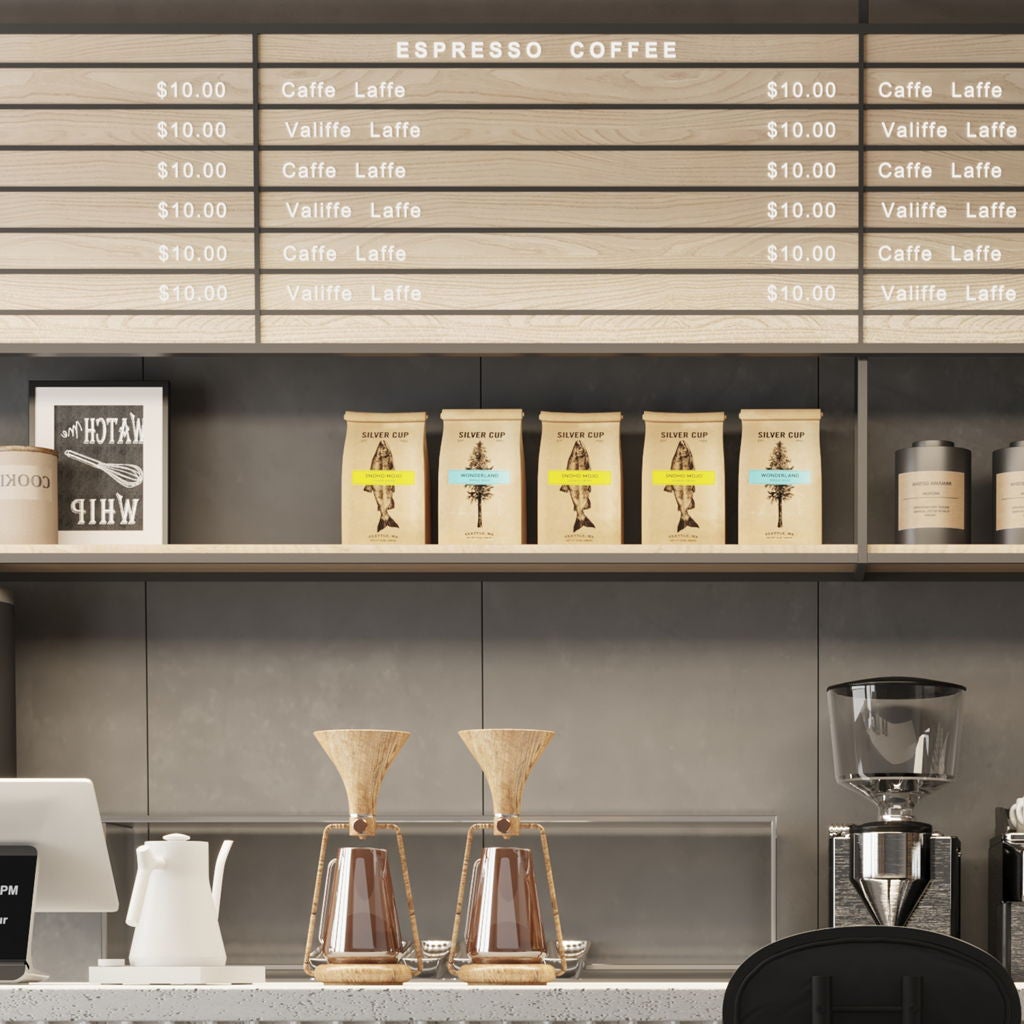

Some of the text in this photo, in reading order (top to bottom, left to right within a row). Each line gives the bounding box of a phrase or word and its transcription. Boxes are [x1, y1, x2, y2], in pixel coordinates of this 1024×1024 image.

[396, 41, 677, 58] ESPRESSO COFFEE
[157, 81, 225, 99] $10.00
[282, 81, 835, 99] Caffe Laffe $10.00
[879, 82, 932, 97] Caffe
[952, 82, 1002, 98] Laffe
[157, 121, 225, 138] $10.00
[285, 121, 835, 139] Valiffe Laffe $10.00
[882, 122, 947, 137] Valiffe
[967, 122, 1017, 138] Laffe
[158, 161, 226, 179] $10.00
[283, 162, 835, 179] Caffe Laffe $10.00
[879, 162, 932, 178] Caffe
[952, 162, 1001, 178] Laffe
[158, 202, 226, 219] $10.00
[286, 202, 835, 219] Valiffe Laffe $10.00
[882, 202, 946, 218] Valiffe
[967, 202, 1016, 218] Laffe
[159, 245, 226, 262] $10.00
[283, 245, 835, 262] Caffe Laffe $10.00
[879, 245, 931, 261] Caffe
[951, 245, 1001, 261] Laffe
[159, 285, 227, 302] $10.00
[767, 284, 835, 302] $10.00
[361, 431, 409, 439] SILVER CUP
[458, 431, 506, 439] SILVER CUP
[557, 431, 605, 439] SILVER CUP
[661, 431, 708, 439] SILVER CUP
[758, 431, 805, 439] SILVER CUP
